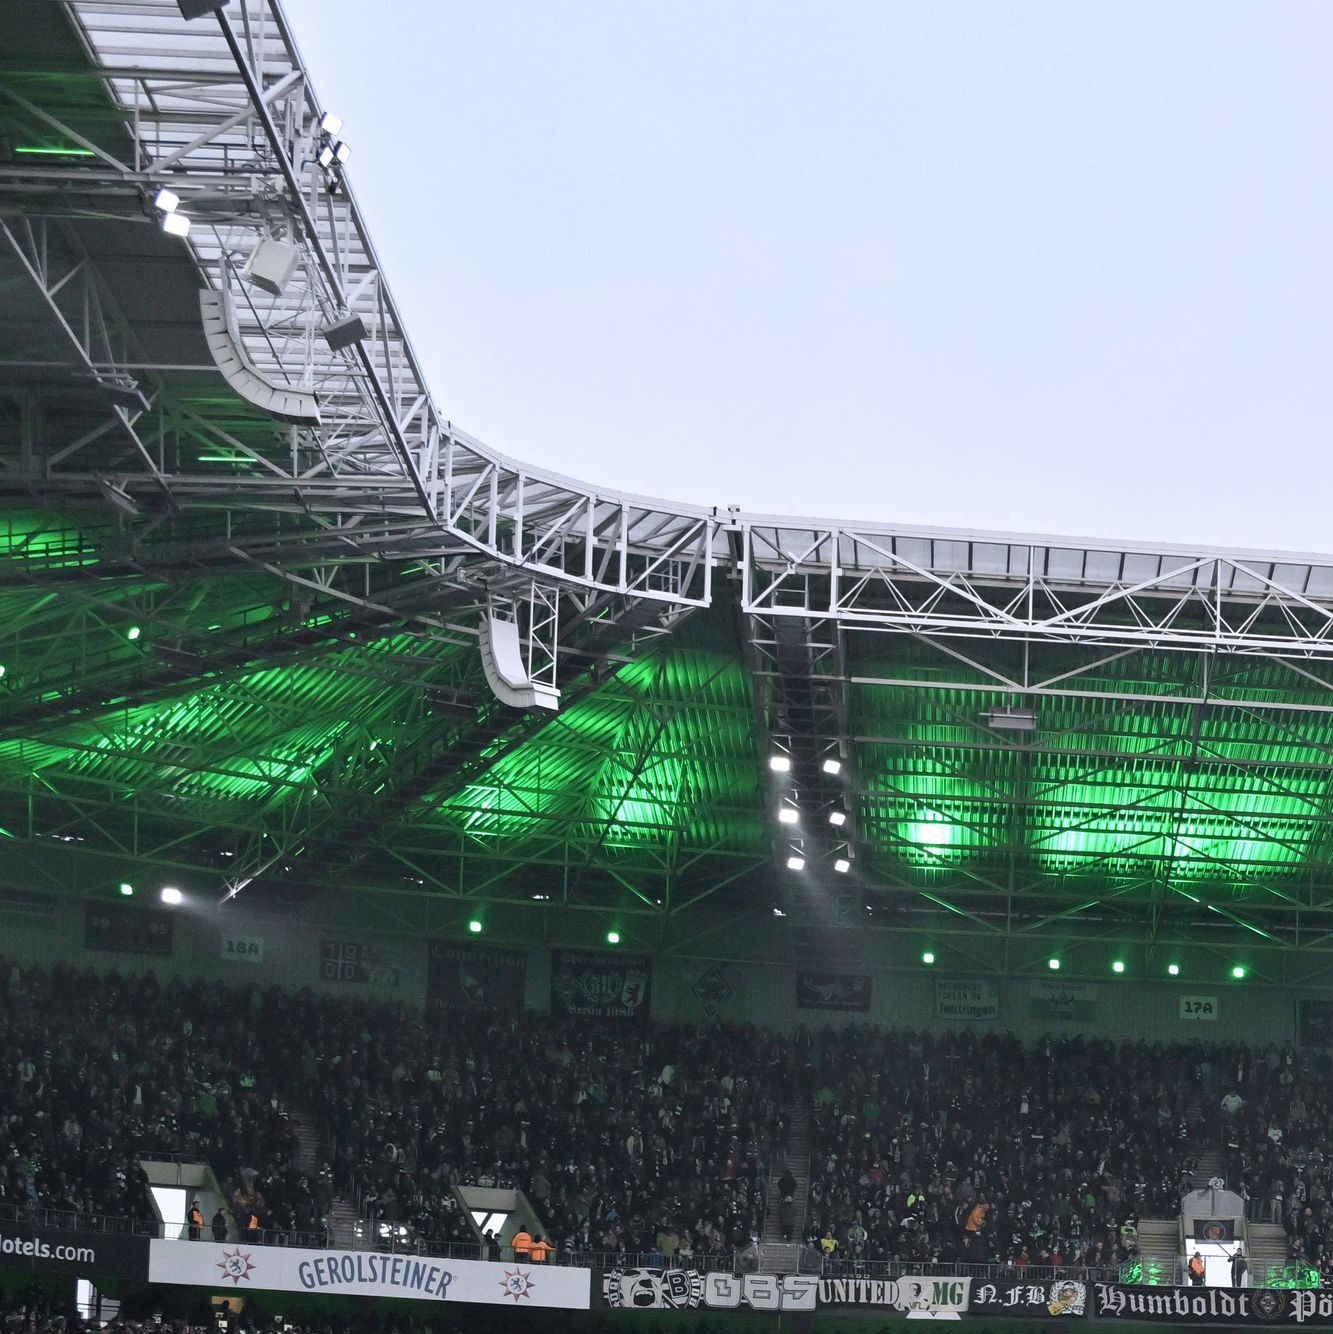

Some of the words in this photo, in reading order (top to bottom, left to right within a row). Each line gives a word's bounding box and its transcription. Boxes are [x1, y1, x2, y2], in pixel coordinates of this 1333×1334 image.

[226, 939, 259, 955] 18A
[1184, 1002, 1213, 1014] 17A
[0, 1234, 95, 1263] otels.com
[299, 1254, 452, 1299] GEROLSTEINER
[818, 1278, 899, 1305] UNITED
[932, 1281, 964, 1307] MG
[1095, 1284, 1250, 1316] Humboldt
